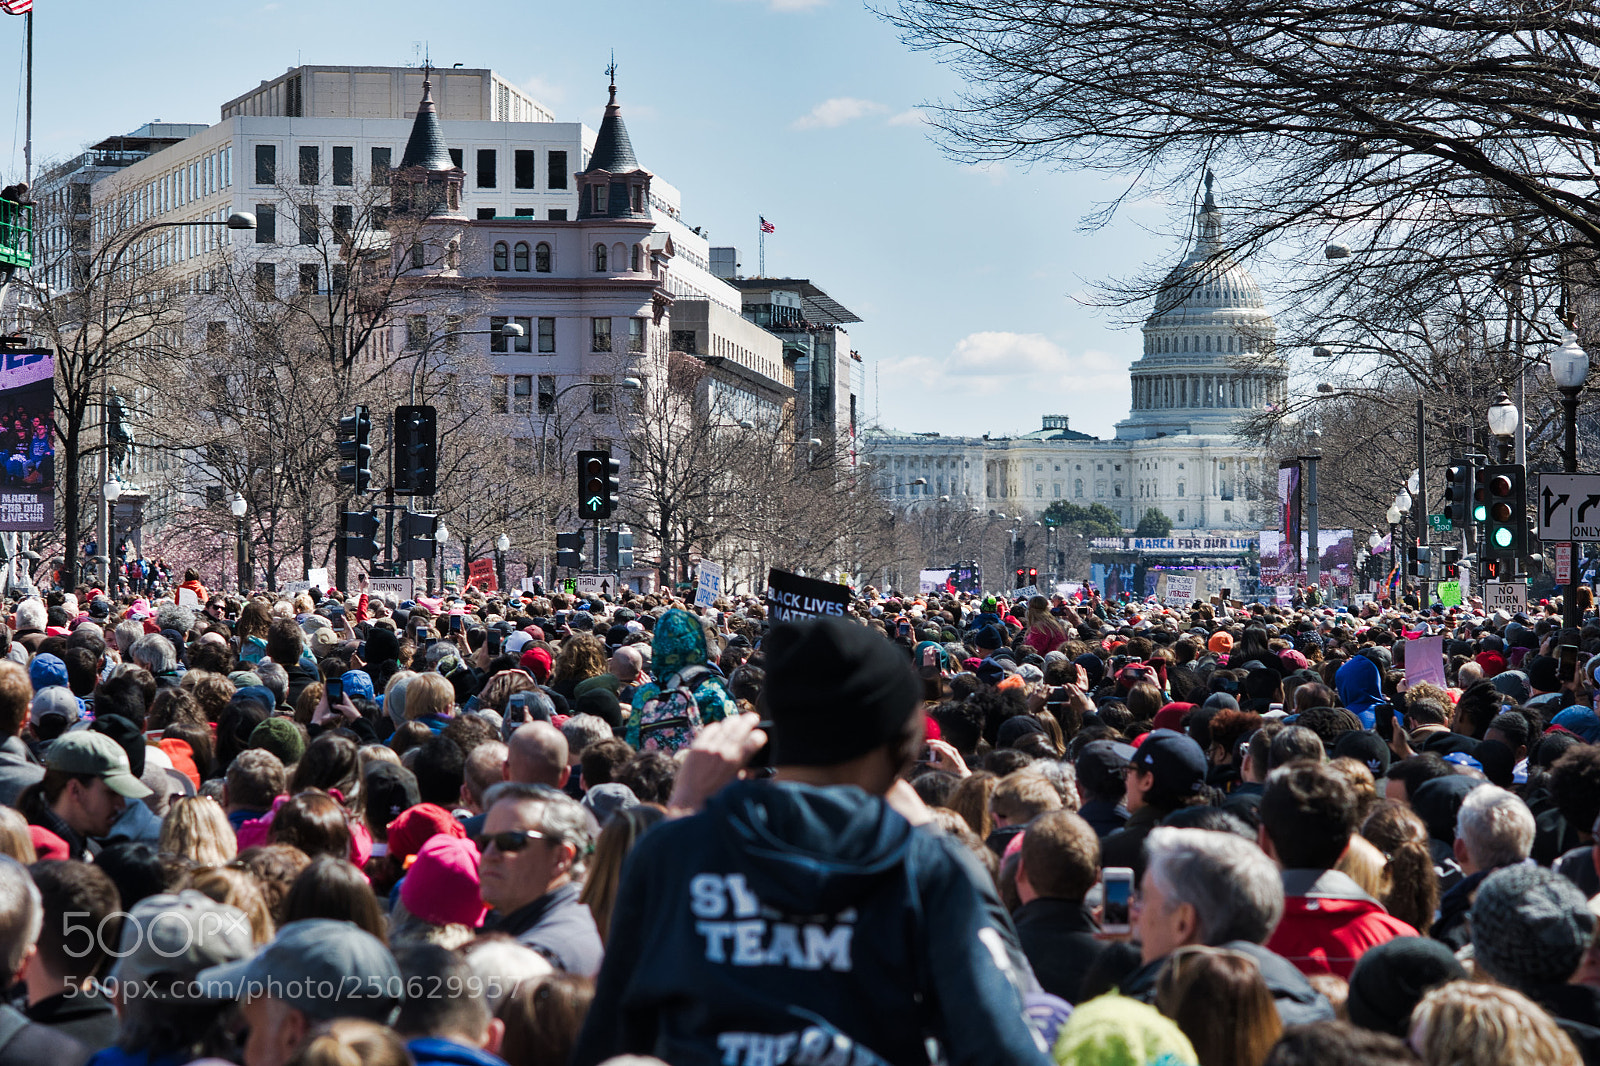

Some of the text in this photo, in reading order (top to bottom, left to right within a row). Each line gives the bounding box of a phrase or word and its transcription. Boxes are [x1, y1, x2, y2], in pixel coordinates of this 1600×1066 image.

[1, 494, 38, 503] MARCH
[1, 504, 44, 512] FOR OUR
[1135, 538, 1174, 549] MARCH
[1178, 538, 1200, 549] FOR
[1204, 538, 1227, 549] OUR
[1448, 565, 1454, 576] 4
[1489, 563, 1496, 577] 4
[578, 578, 597, 586] THRU
[372, 583, 402, 592] TURNING
[1498, 587, 1514, 595] NO
[768, 586, 844, 617] BLACK LIVES
[1494, 596, 1519, 604] TURN
[696, 920, 852, 971] TEAM
